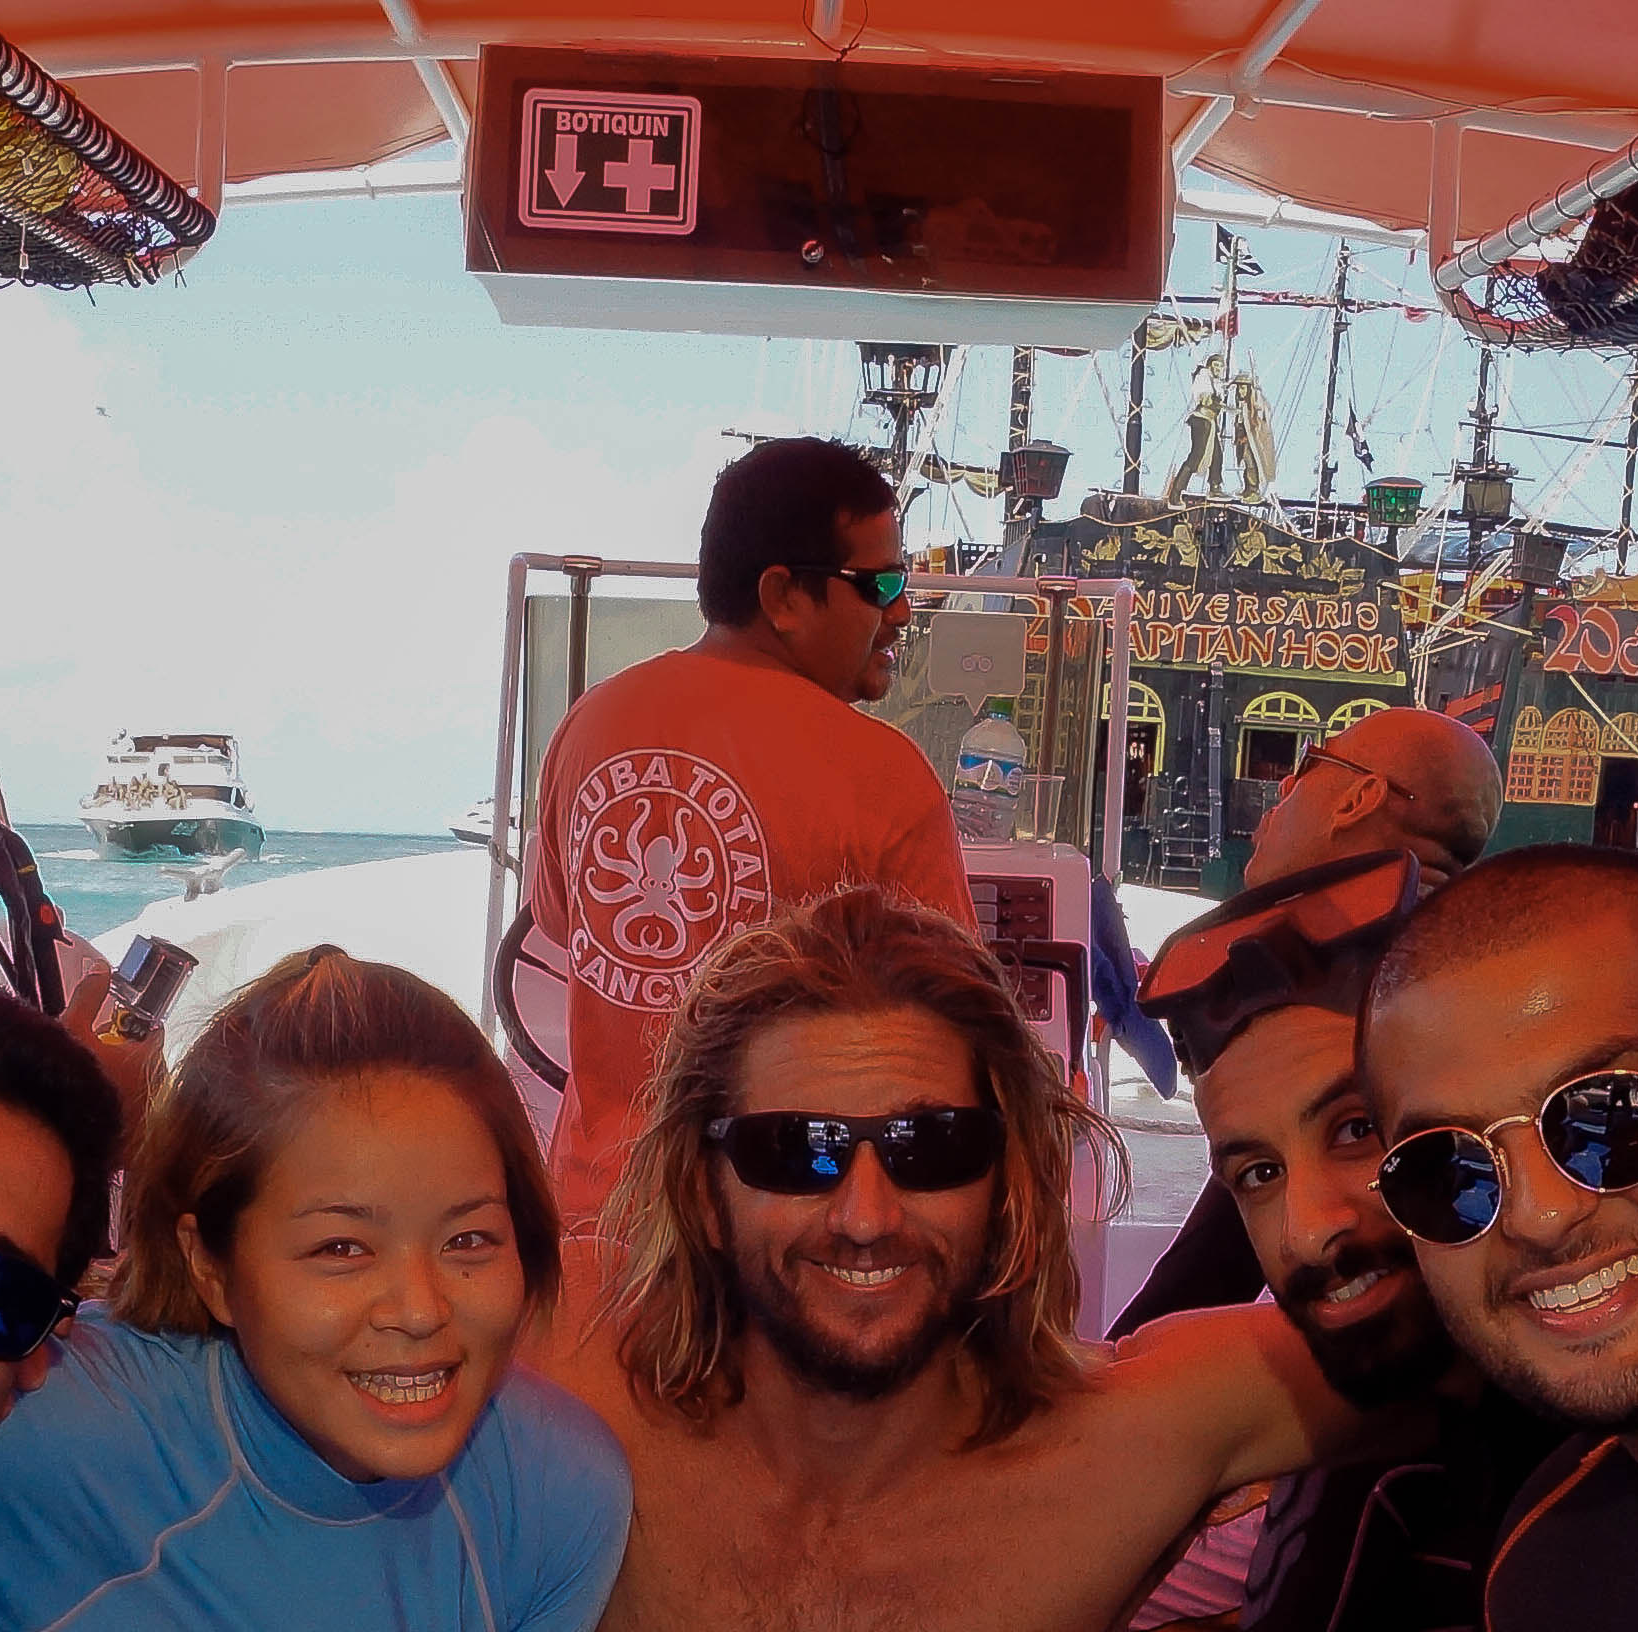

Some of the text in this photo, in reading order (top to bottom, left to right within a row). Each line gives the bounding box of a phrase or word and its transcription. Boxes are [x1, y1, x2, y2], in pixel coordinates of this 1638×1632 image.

[556, 111, 669, 137] BOTIQUIN
[1105, 619, 1399, 674] APITAN HOOK
[1544, 606, 1619, 675] 20
[688, 765, 766, 912] TOTAL
